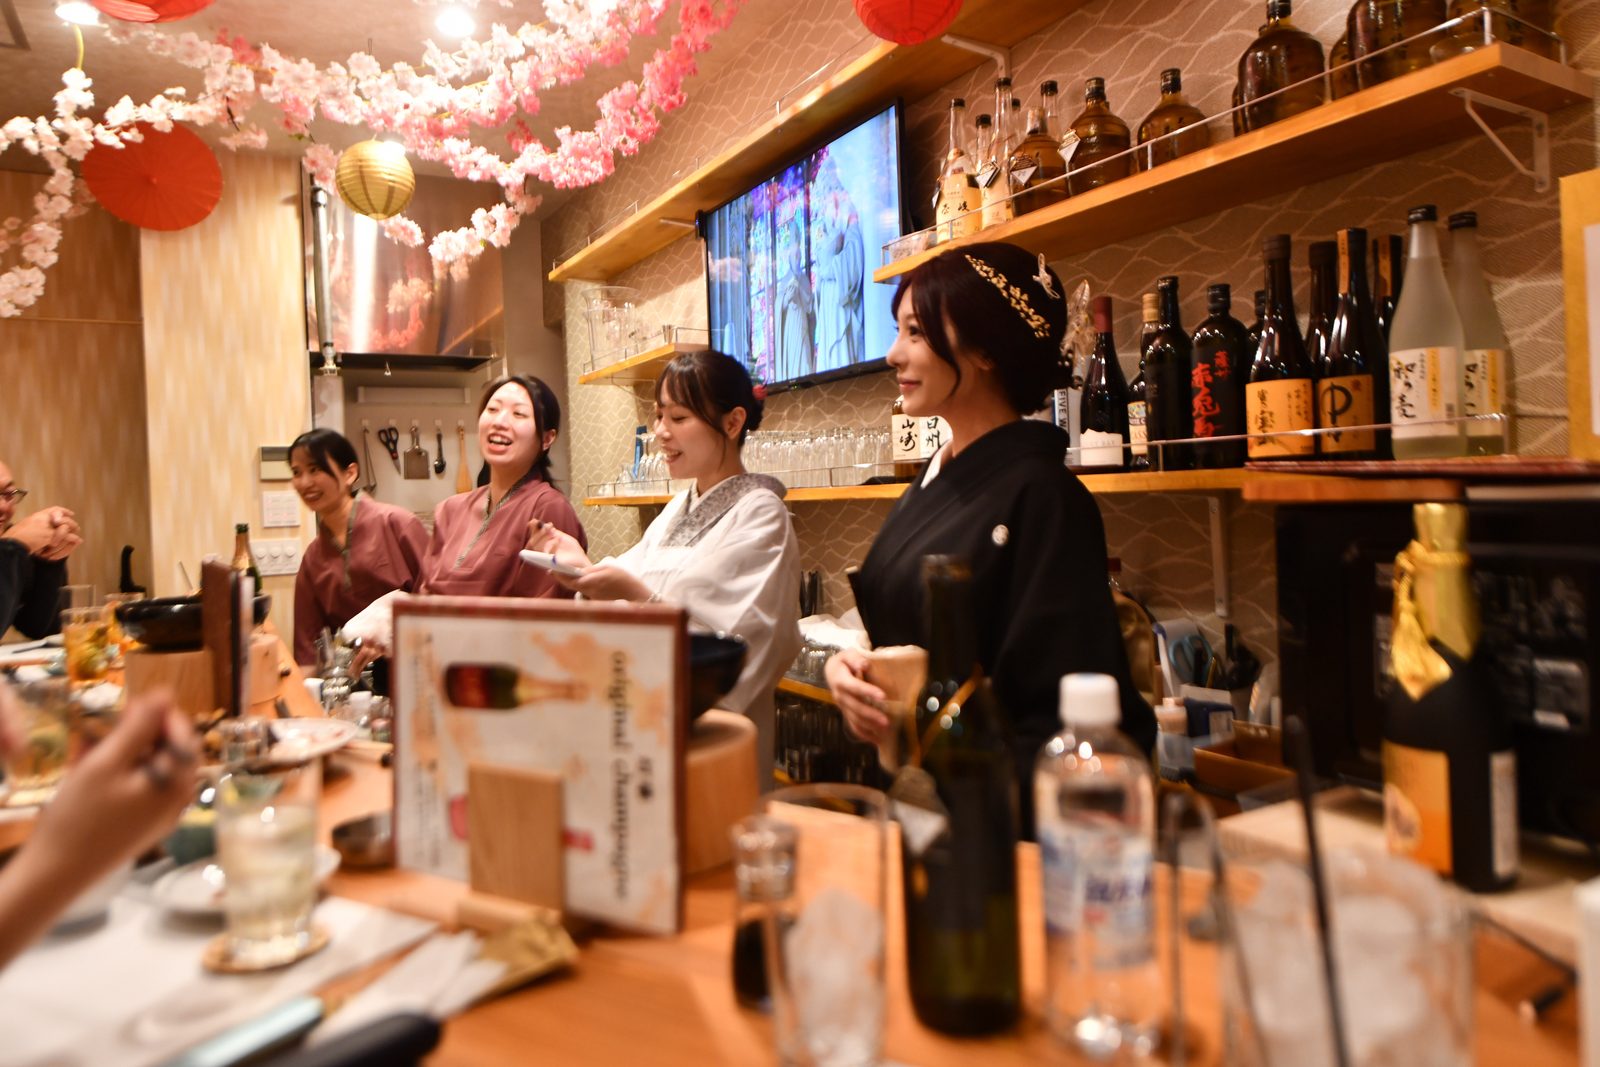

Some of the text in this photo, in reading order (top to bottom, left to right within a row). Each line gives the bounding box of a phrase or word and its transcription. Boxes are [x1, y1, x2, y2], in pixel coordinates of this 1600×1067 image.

[899, 418, 918, 452] 山崎
[609, 651, 632, 901] original champagne
